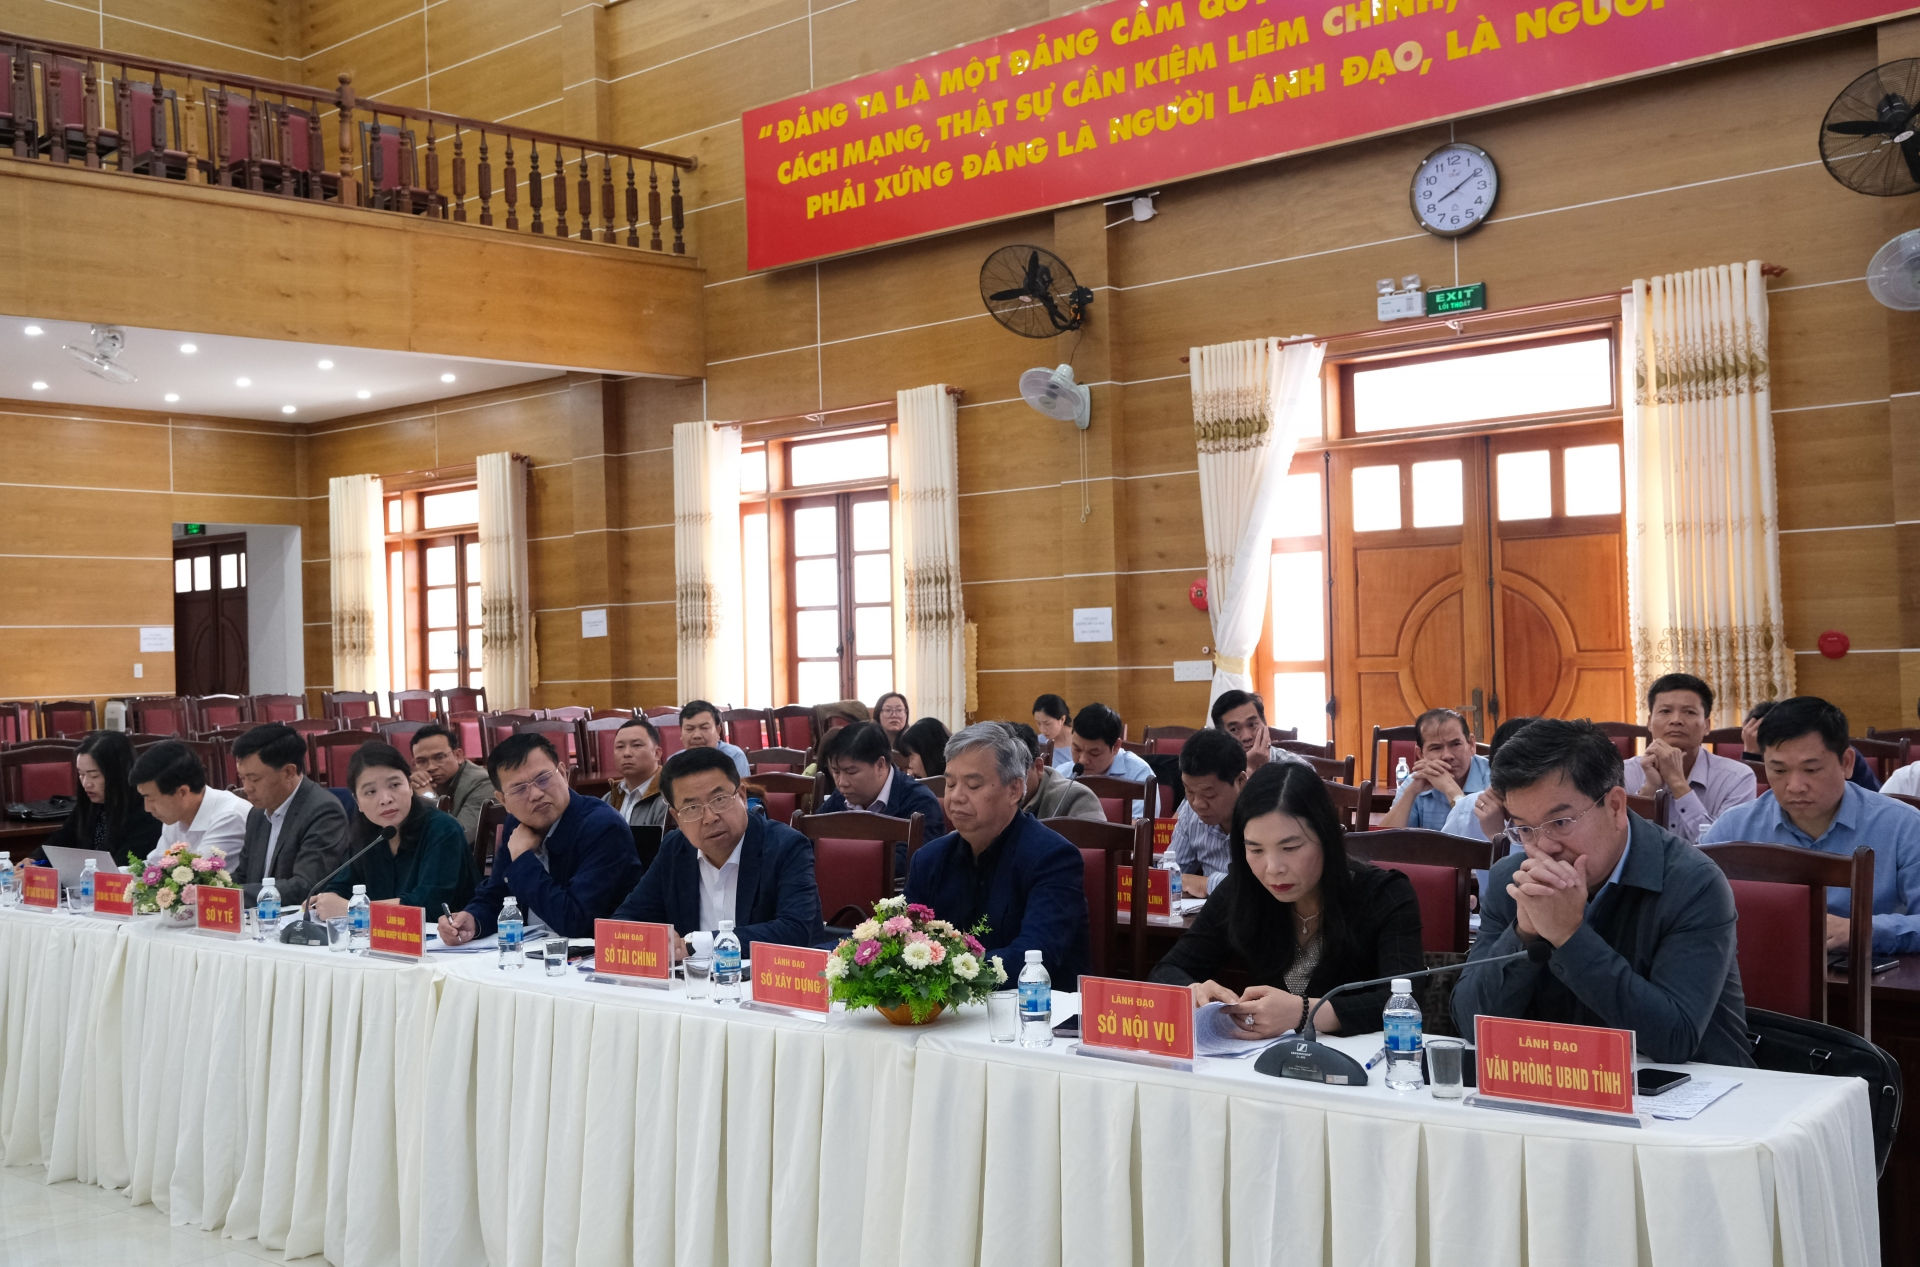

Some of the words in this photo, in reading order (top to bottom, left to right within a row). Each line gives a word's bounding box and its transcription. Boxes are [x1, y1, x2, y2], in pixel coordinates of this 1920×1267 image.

[856, 91, 889, 119] TA
[895, 73, 931, 109] LÀ
[939, 55, 1001, 97] MỘT
[1008, 28, 1099, 76] ĐẢNG
[777, 147, 838, 185] CÁCH
[842, 124, 931, 168] MẠNG,
[936, 98, 1008, 141] THẬT
[1015, 82, 1056, 122] SỰ
[1062, 65, 1126, 107] CẦN
[1135, 41, 1218, 89] KIỆM
[1227, 16, 1310, 63] LIÊM
[806, 178, 866, 220] PHẢI
[874, 160, 953, 202] XỨNG
[961, 137, 1048, 180] ĐÁNG
[1057, 120, 1098, 157] LÀ
[1109, 90, 1215, 144] NGƯỜI
[1228, 63, 1325, 114] LÃNH
[1340, 40, 1433, 87] ĐẠO,
[1446, 15, 1501, 61] LÀ
[1447, 155, 1461, 166] 12
[1435, 163, 1444, 173] 11
[1473, 167, 1483, 177] 2
[1426, 175, 1437, 186] 10
[1477, 180, 1488, 190] 3
[1422, 190, 1433, 200] 9
[1474, 196, 1483, 205] 4
[1426, 203, 1436, 214] 8
[1465, 208, 1475, 219] 5
[1437, 213, 1446, 223] 7
[1450, 215, 1460, 225] 6
[1435, 289, 1474, 303] EXIT
[217, 909, 223, 922] Y
[617, 945, 629, 964] TÀI
[631, 947, 657, 967] CHÍNH
[794, 977, 821, 995] DỰNG
[1111, 993, 1134, 1006] LÃNH
[1136, 997, 1155, 1009] ĐẠO
[1097, 1009, 1117, 1035] SỞ
[1122, 1014, 1148, 1042] NỘI
[1153, 1021, 1175, 1047] VỤ
[1518, 1036, 1549, 1050] LÃNH
[1553, 1040, 1578, 1054] ĐẠO
[1486, 1054, 1509, 1081] VĂN
[1512, 1057, 1552, 1087] PHÒNG
[1555, 1065, 1589, 1091] UBND
[1592, 1063, 1621, 1095] TỈNH
